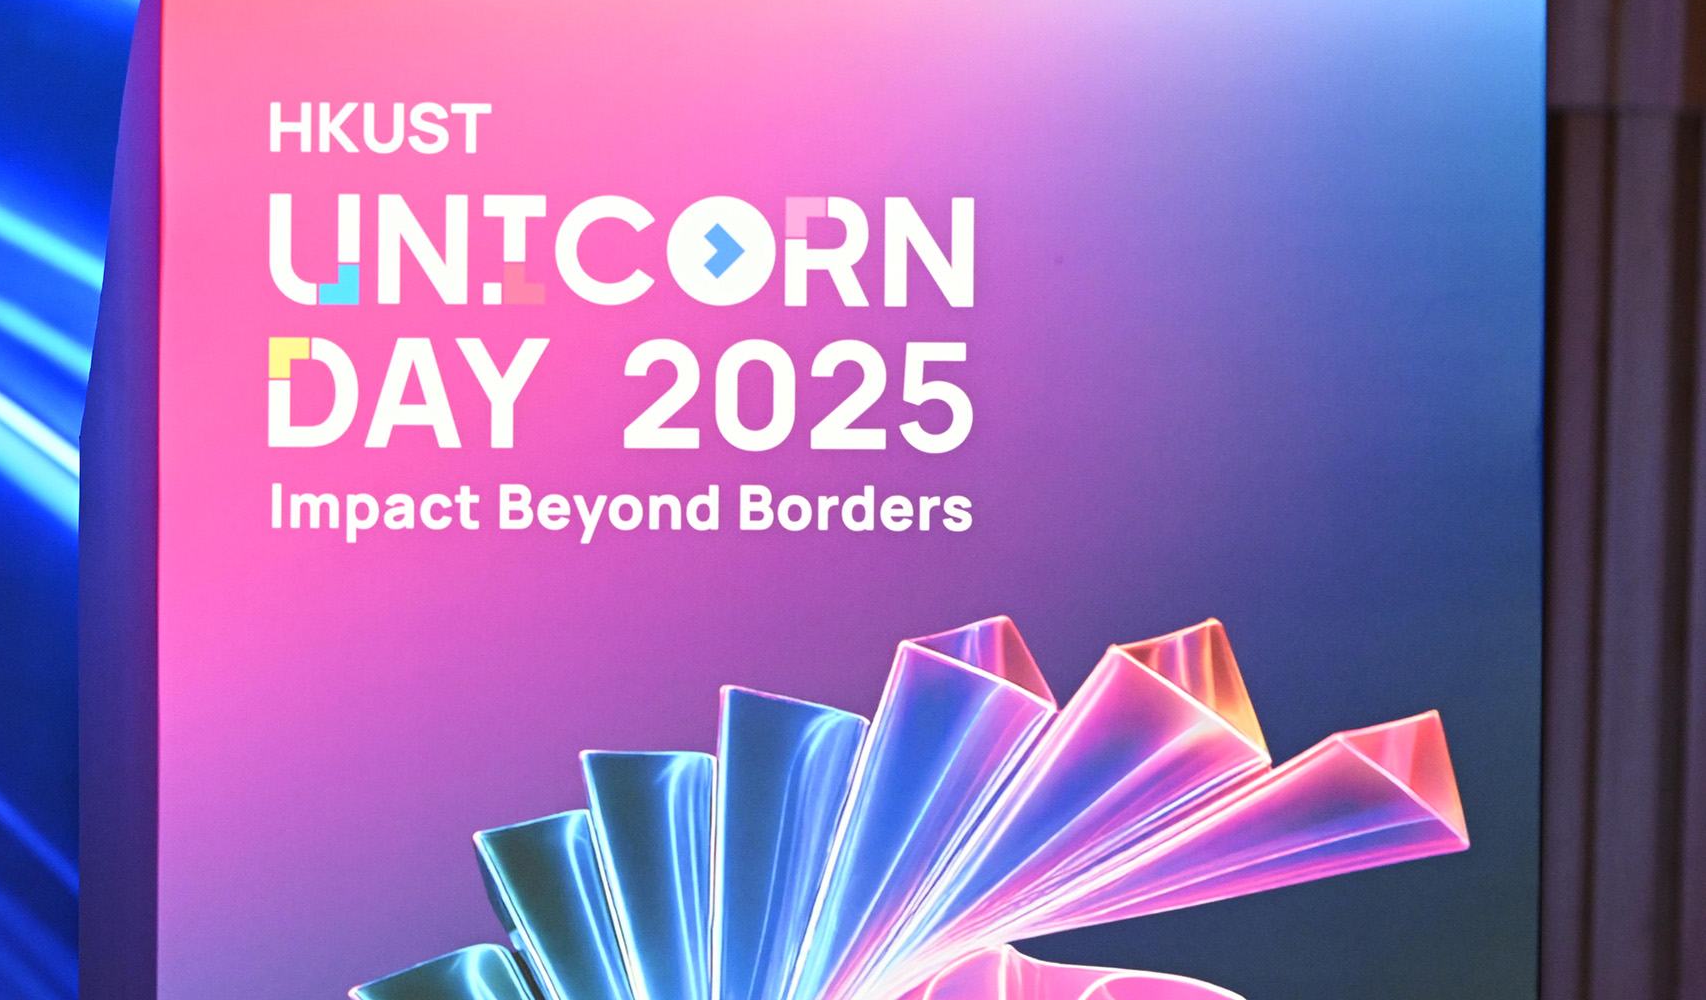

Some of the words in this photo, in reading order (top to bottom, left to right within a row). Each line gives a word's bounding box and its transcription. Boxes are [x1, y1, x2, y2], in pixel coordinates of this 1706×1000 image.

[270, 102, 492, 155] HKUST
[269, 193, 975, 308] UNICORN
[268, 337, 550, 449] DAY
[624, 338, 973, 454] 2025
[271, 483, 480, 543] Impact
[499, 484, 719, 544] Beyond
[740, 484, 973, 532] Borders
